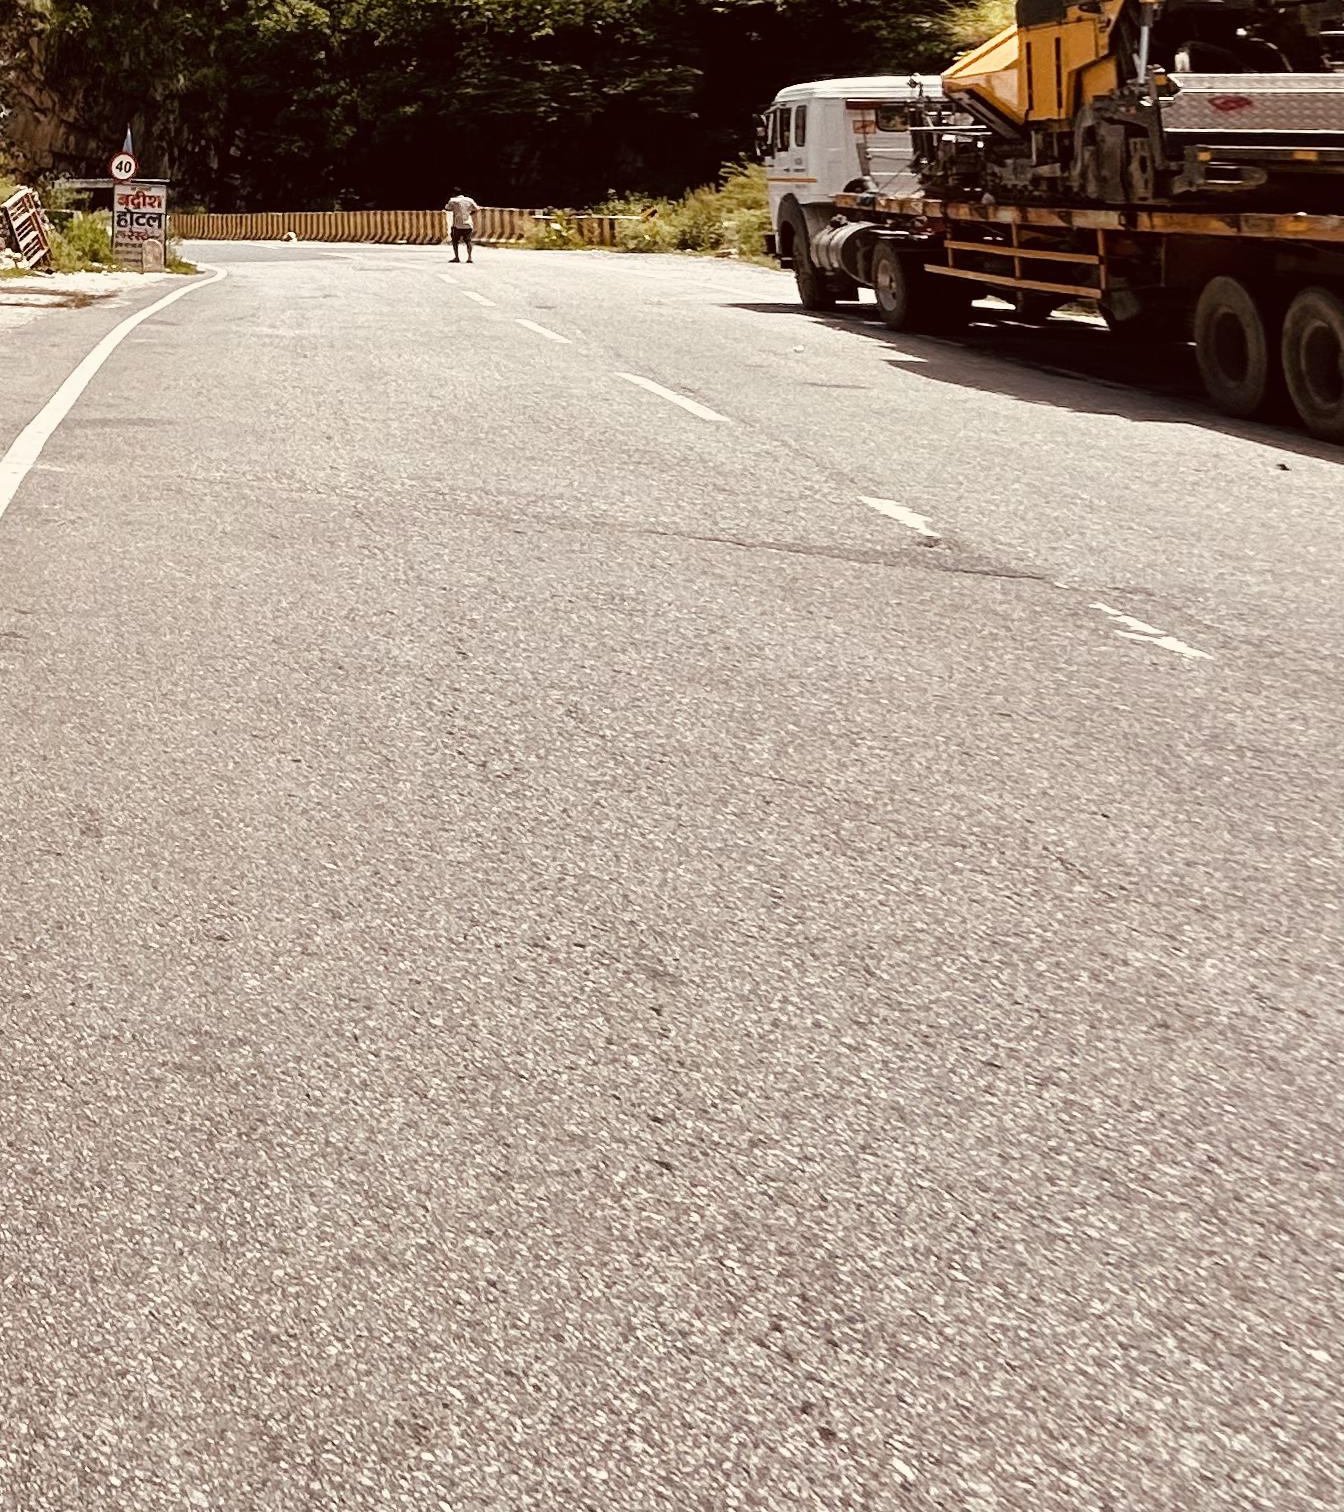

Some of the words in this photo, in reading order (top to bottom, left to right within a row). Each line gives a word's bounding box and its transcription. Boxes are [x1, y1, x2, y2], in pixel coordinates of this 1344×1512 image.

[115, 160, 132, 174] 40
[116, 190, 162, 208] बद्रीश
[115, 207, 163, 228] होटल
